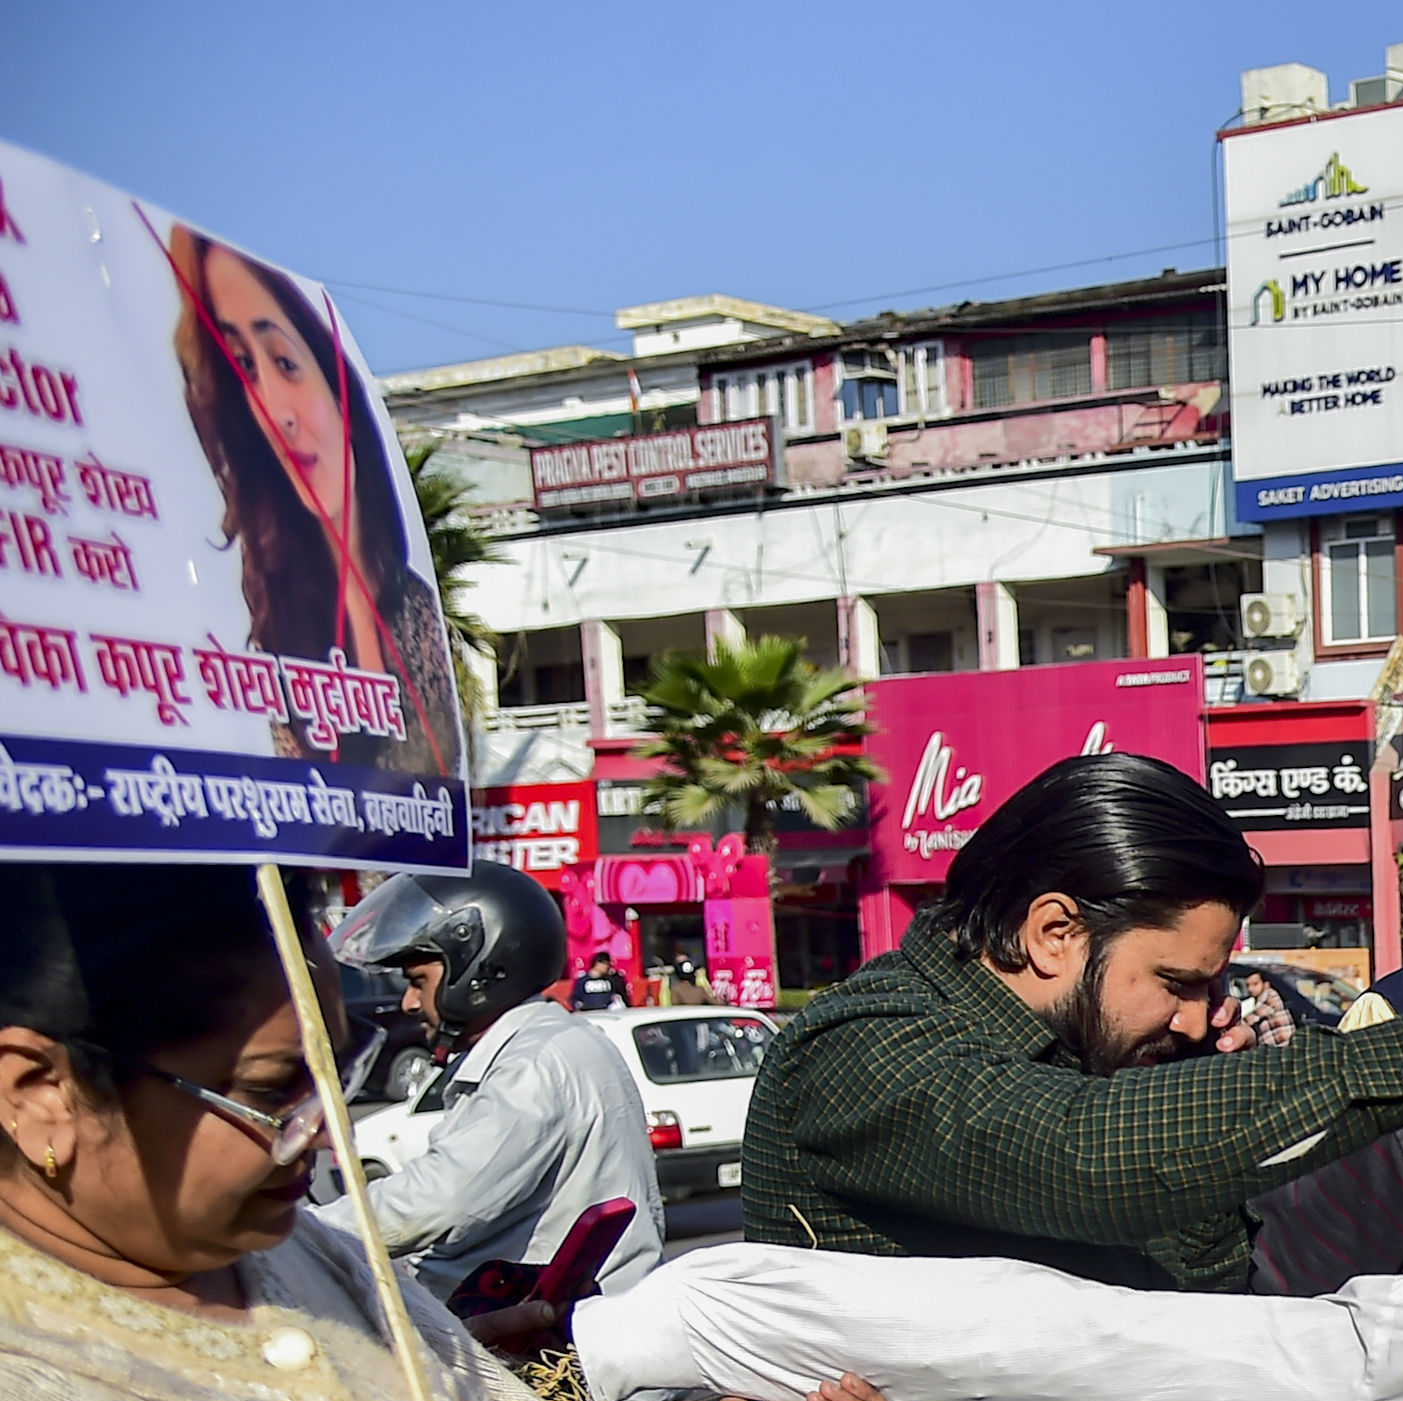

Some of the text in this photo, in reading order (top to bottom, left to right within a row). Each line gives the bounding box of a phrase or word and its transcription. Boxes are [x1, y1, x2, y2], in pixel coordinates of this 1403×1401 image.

[1264, 203, 1384, 239] SAINT-GOBAIN
[1291, 260, 1403, 297] MY HOME
[1262, 367, 1395, 397] MAKING THE WORLD
[1290, 389, 1382, 415] BETTER HOME
[590, 442, 628, 480] PEST
[628, 433, 695, 477] CONTROL
[694, 422, 769, 468] SERVICES
[73, 450, 160, 521] शेख
[1257, 486, 1306, 507] SAKET
[66, 530, 142, 593] करो
[88, 631, 194, 728] कपूर
[281, 648, 406, 748] मुर्दाबाद
[903, 731, 983, 829] Mia
[1210, 761, 1277, 799] किंग्स
[1281, 763, 1330, 797] एण्ड
[204, 775, 316, 838] परशुराम
